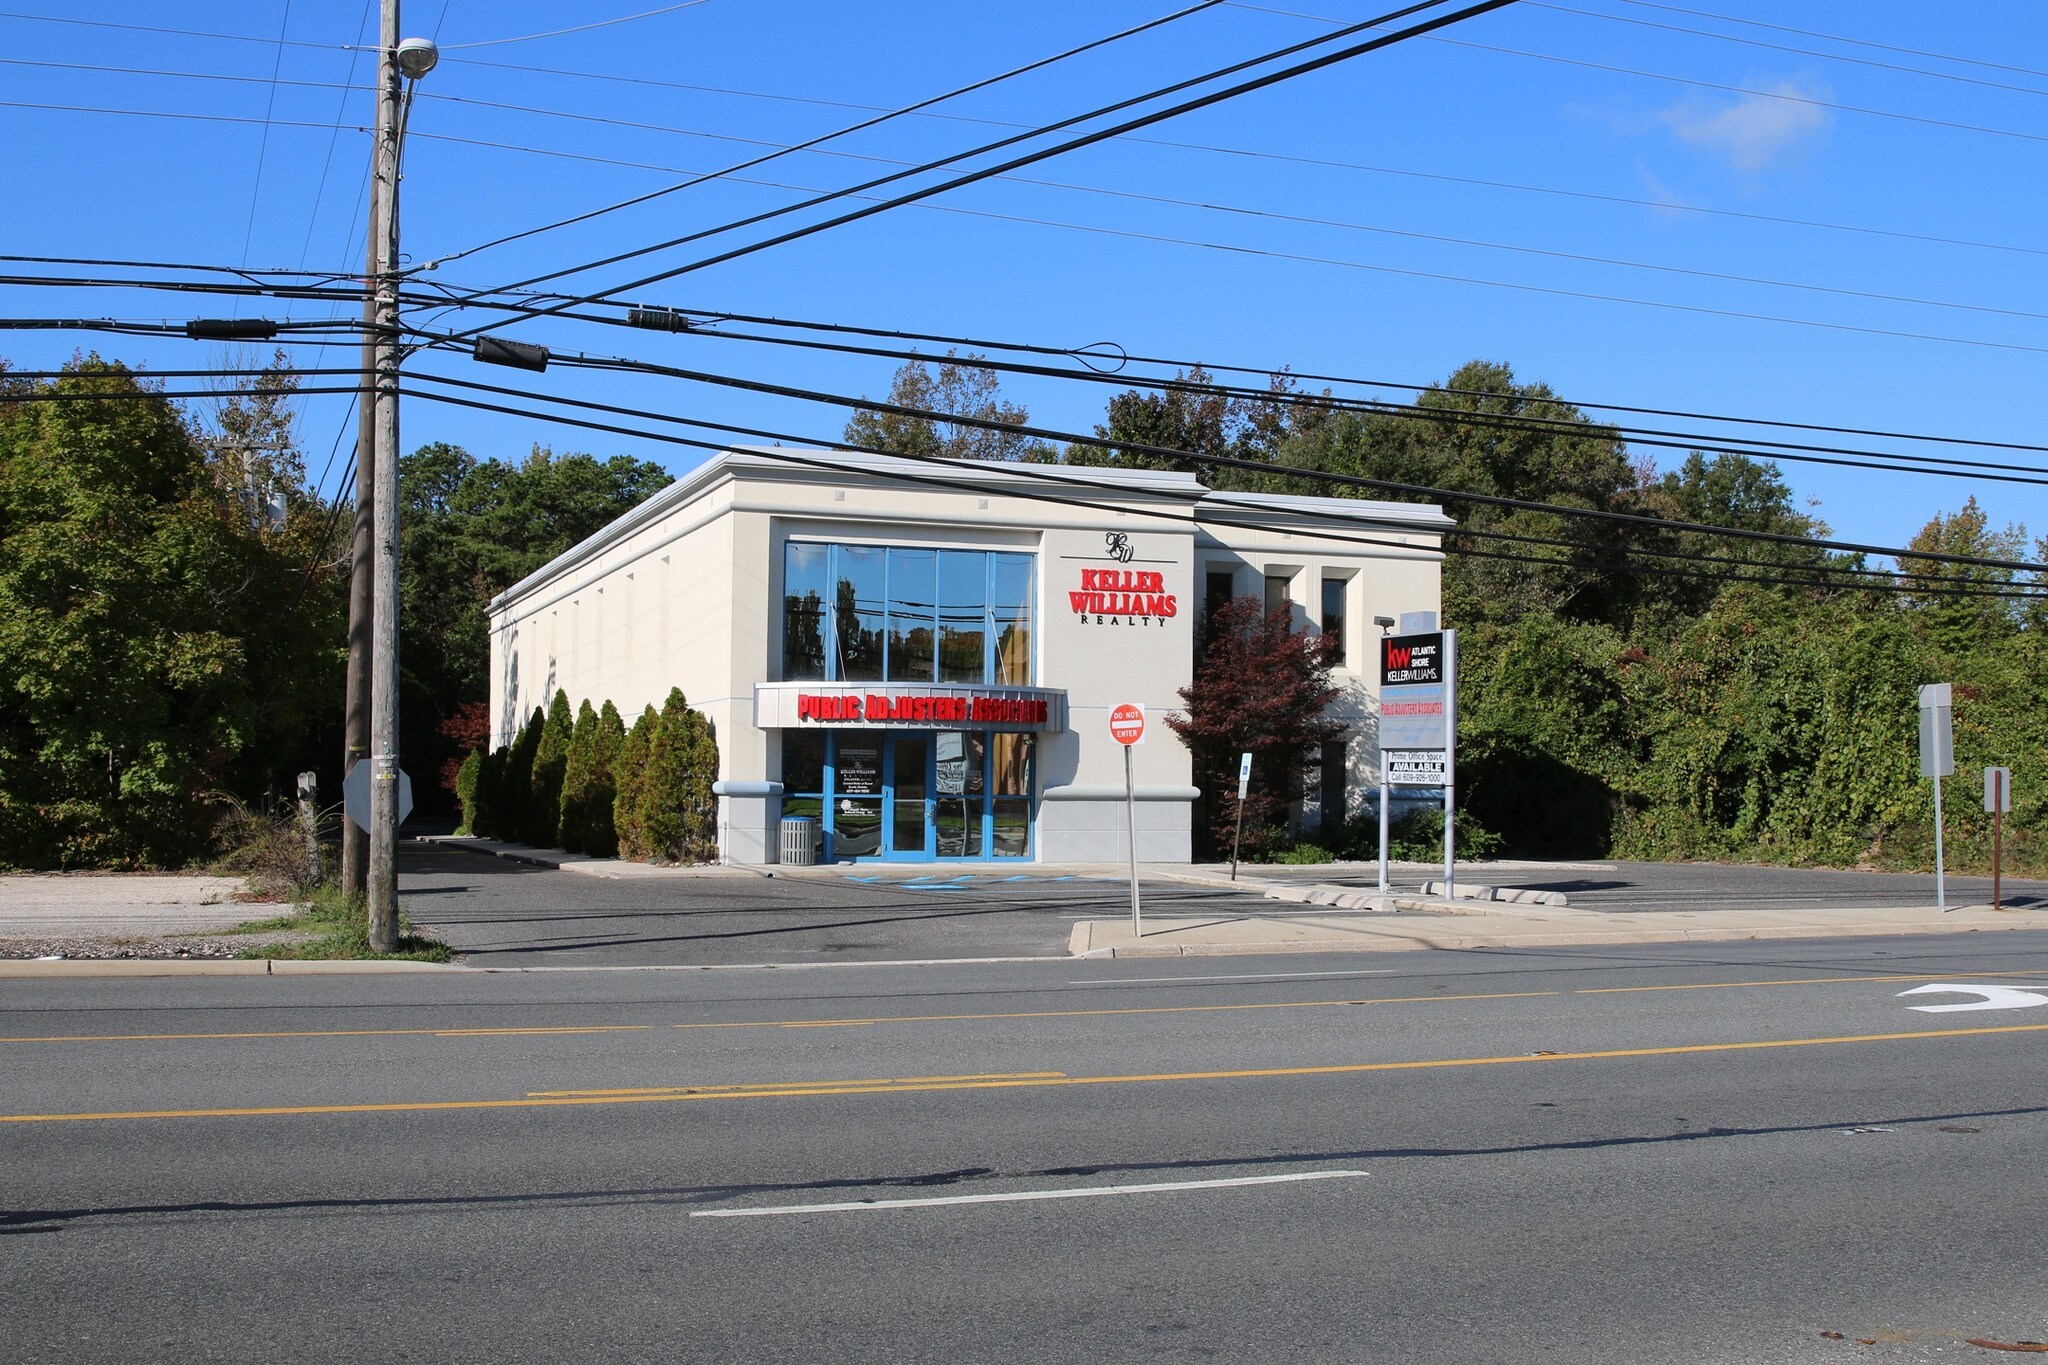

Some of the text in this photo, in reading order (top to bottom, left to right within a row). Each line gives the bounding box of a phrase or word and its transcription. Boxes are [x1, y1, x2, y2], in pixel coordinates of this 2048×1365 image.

[1081, 569, 1165, 593] KELLER
[1068, 591, 1178, 617] WILLIAMS
[1081, 615, 1165, 627] REALTY
[1387, 639, 1411, 669] kw
[1411, 645, 1437, 656] ATLANTIC
[1411, 657, 1430, 668] SHORE
[798, 695, 1048, 722] PUBLIC ADJUSTERS ASSOCIATES
[1381, 703, 1395, 716] PUBLIC
[1418, 701, 1442, 714] ASSOCIATES
[1125, 711, 1139, 719] NOT
[1117, 729, 1138, 738] ENTER
[1391, 751, 1443, 762] Prime Office Space
[1392, 762, 1442, 772] AVAILABLE
[1391, 773, 1402, 781] Call
